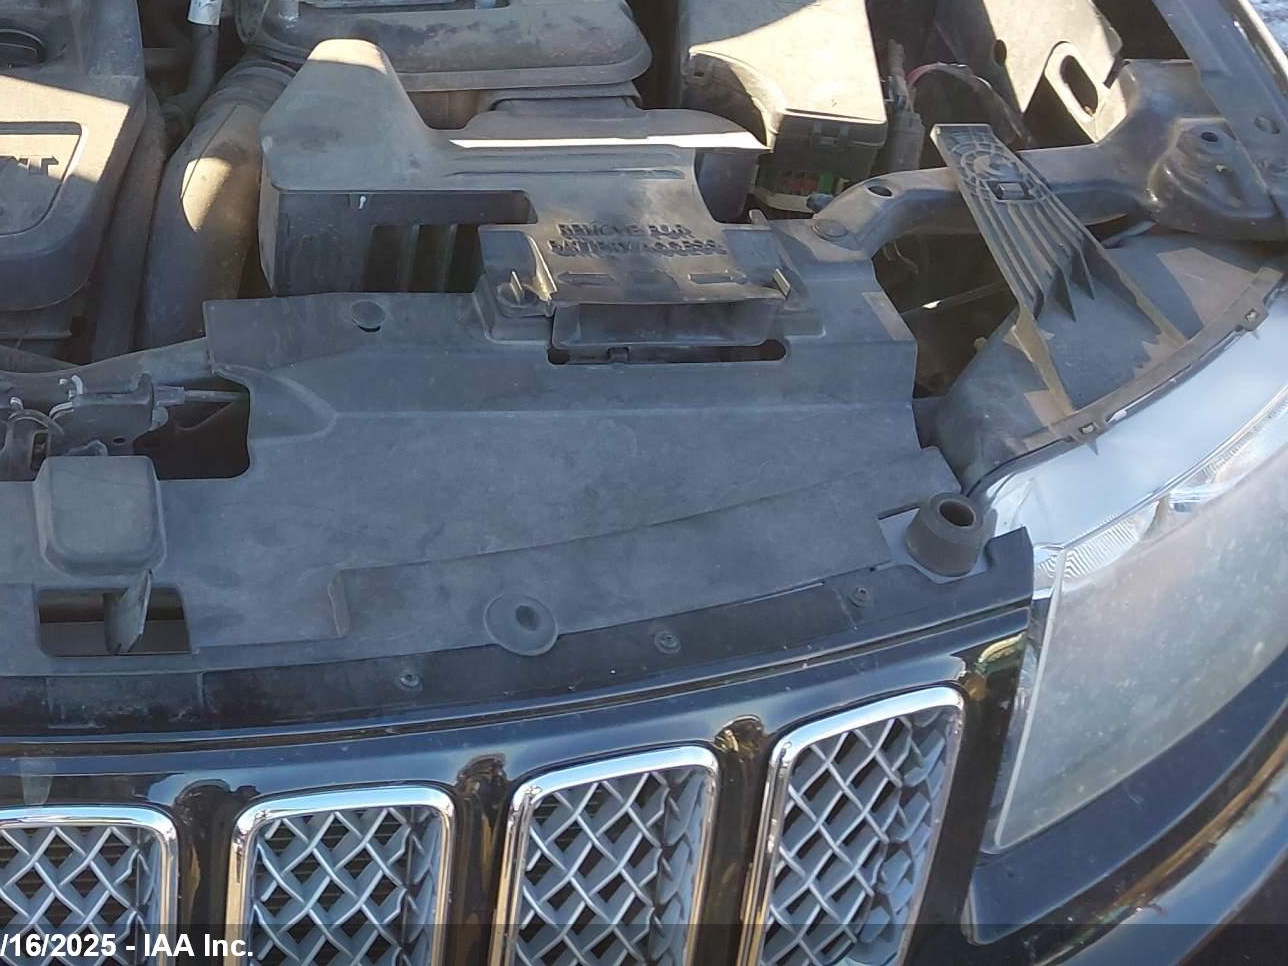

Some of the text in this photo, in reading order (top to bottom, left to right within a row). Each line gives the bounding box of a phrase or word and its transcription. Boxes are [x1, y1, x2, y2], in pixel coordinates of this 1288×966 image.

[557, 223, 695, 240] REMOVE FOR
[548, 240, 728, 258] BATTERY ACCESS
